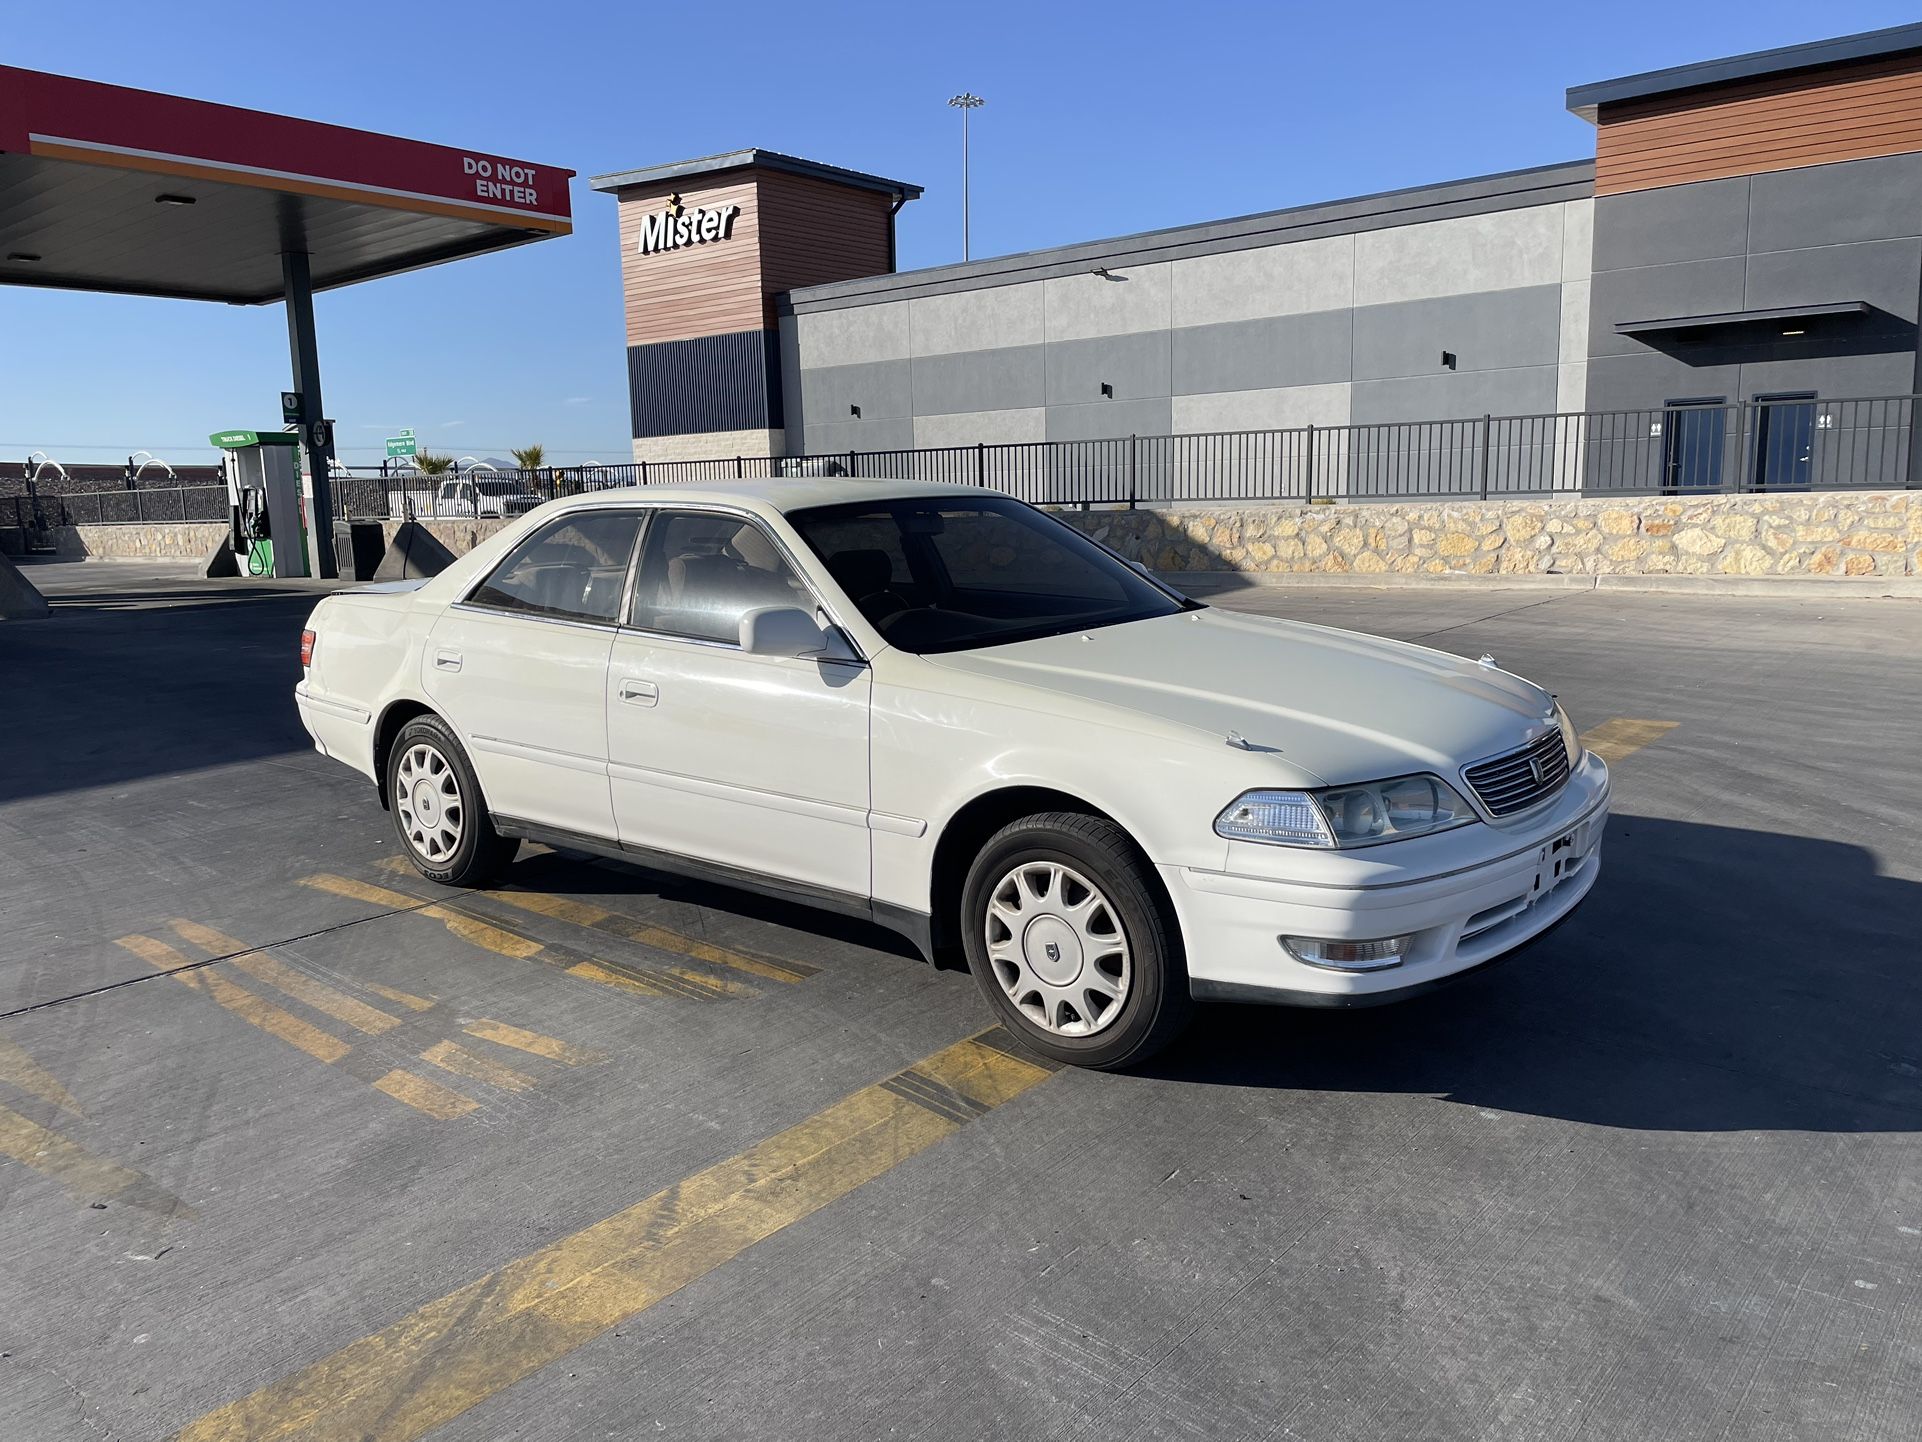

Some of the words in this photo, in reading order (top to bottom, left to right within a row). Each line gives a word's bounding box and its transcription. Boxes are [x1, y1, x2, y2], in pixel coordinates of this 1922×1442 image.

[463, 157, 492, 177] DO
[497, 163, 536, 185] NOT
[476, 179, 538, 205] ENTER
[638, 205, 735, 253] Mister
[287, 397, 293, 407] 1
